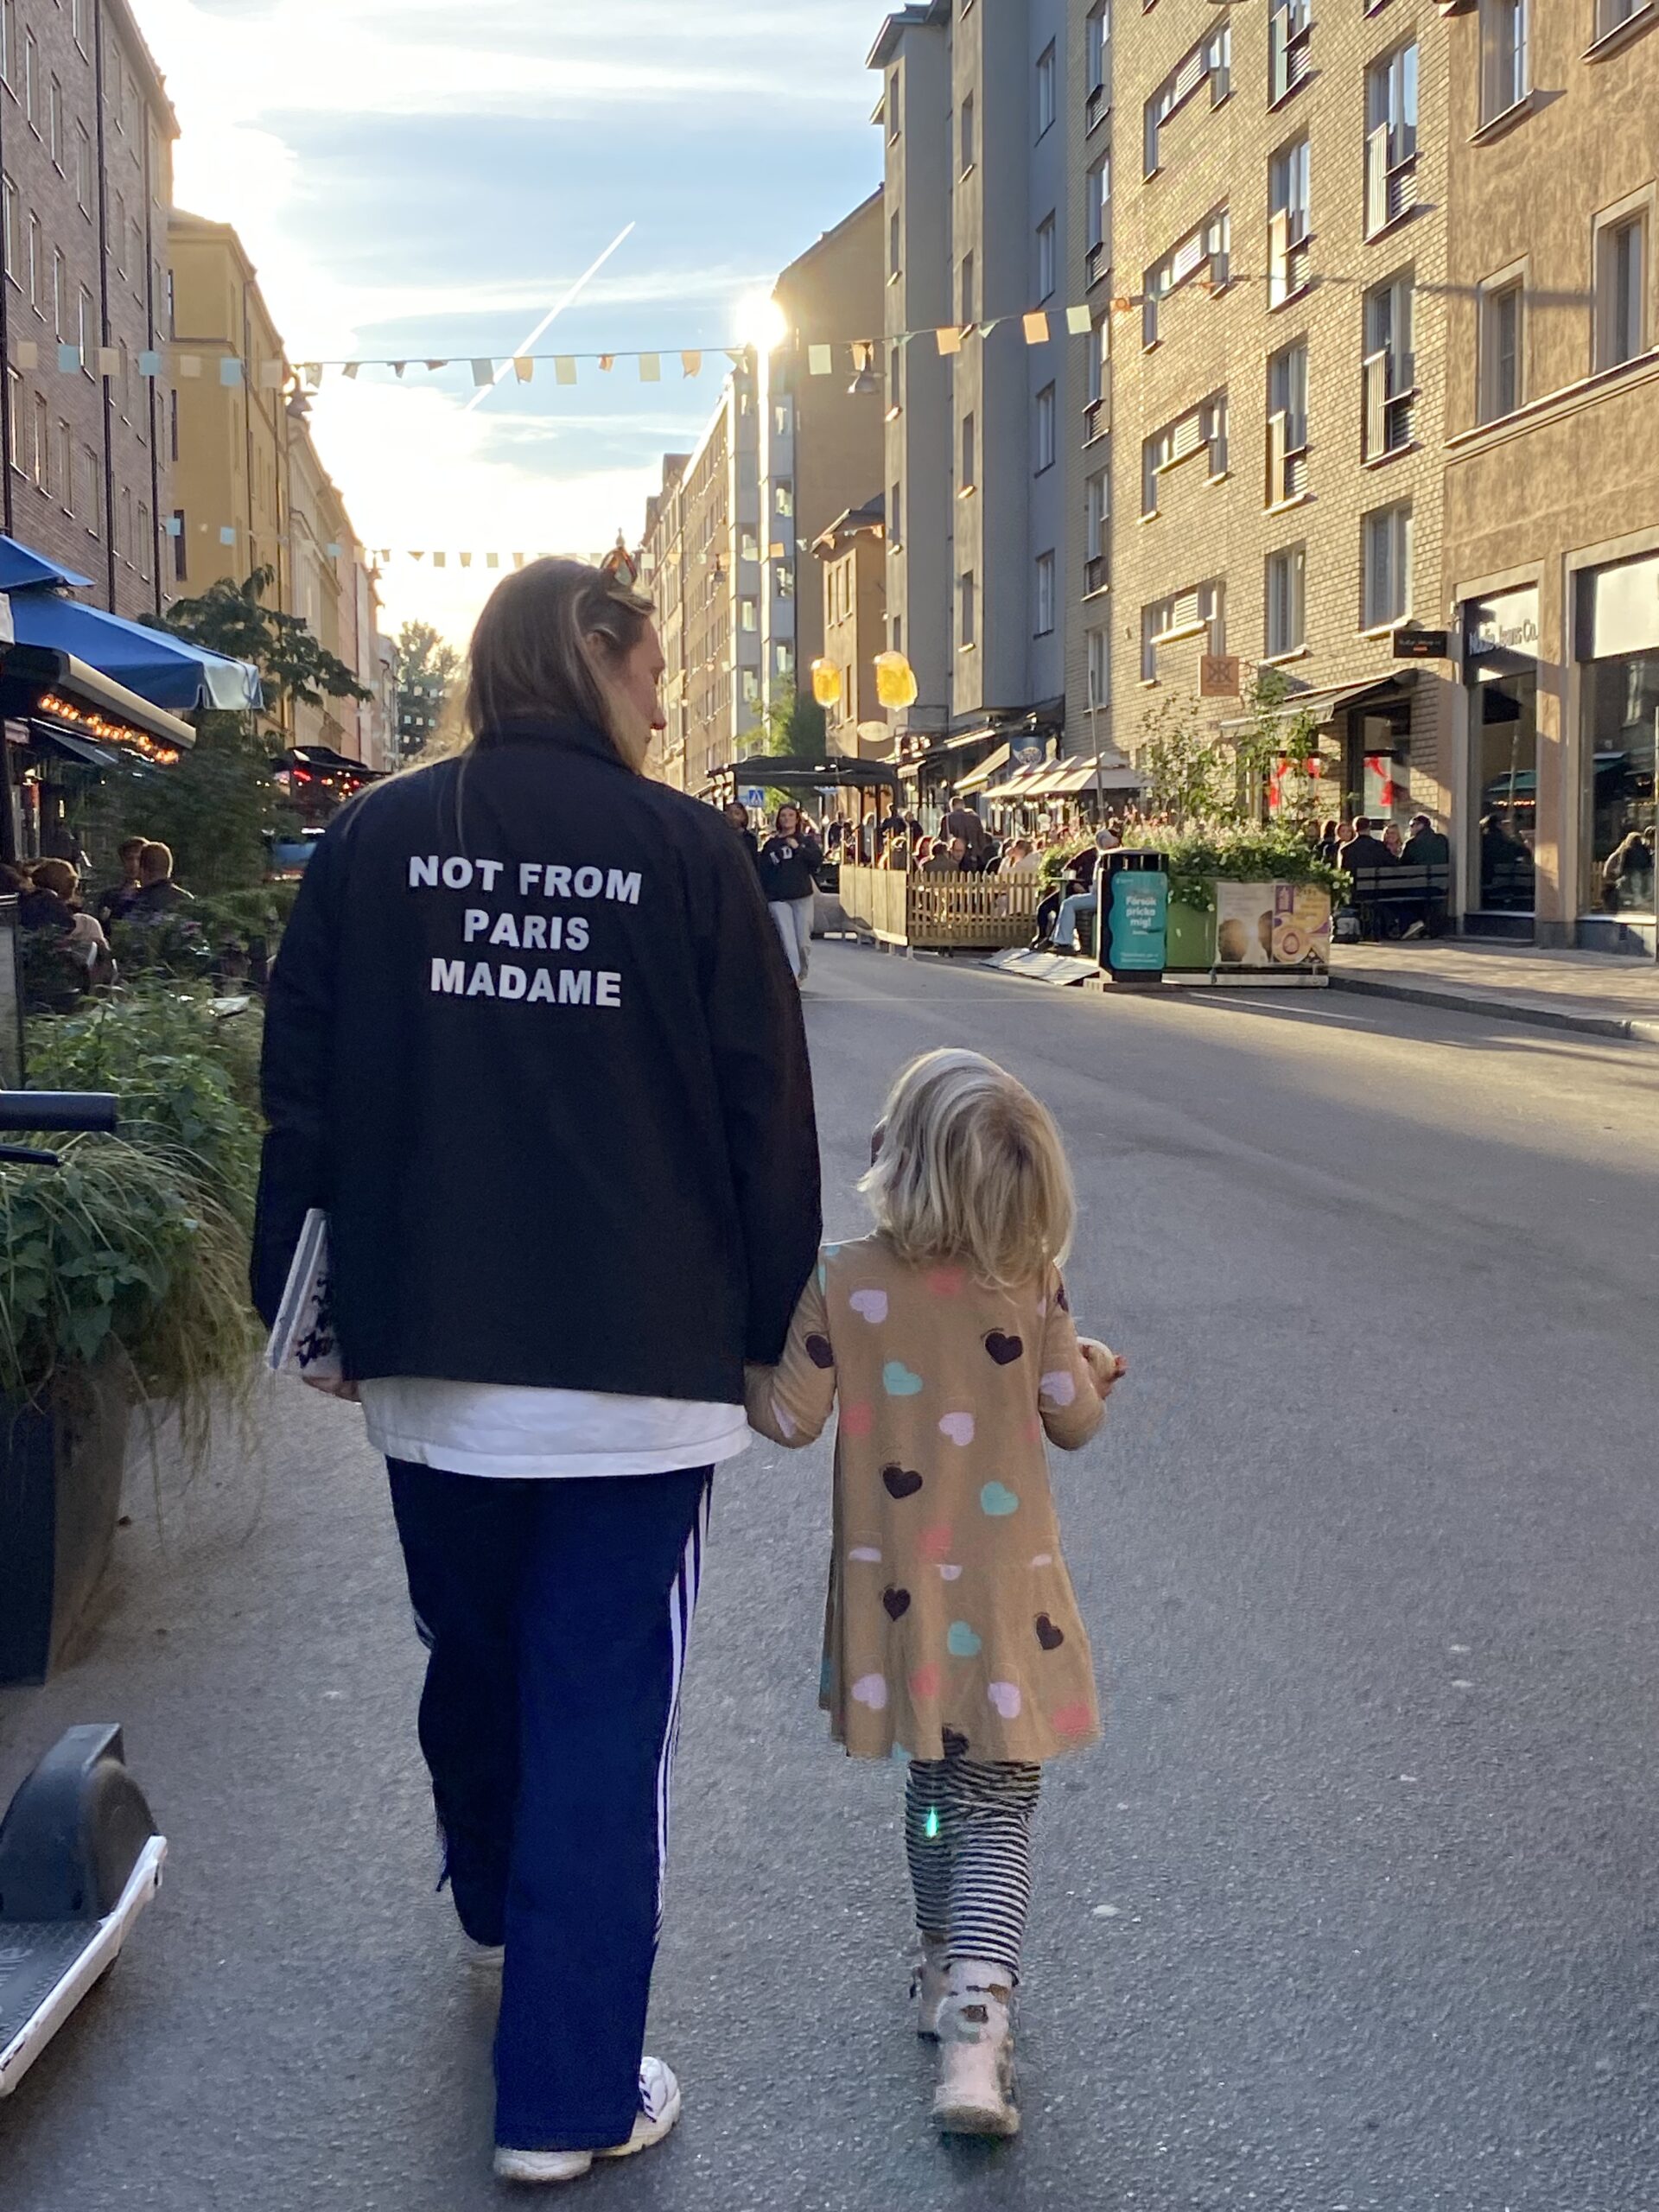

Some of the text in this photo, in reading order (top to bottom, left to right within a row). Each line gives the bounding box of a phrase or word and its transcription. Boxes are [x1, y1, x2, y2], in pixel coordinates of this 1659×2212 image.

[409, 855, 642, 905] NOT FROM
[464, 908, 589, 950] PARIS
[1126, 907, 1155, 918] pricka
[1130, 918, 1151, 928] mig!
[430, 957, 621, 1007] MADAME
